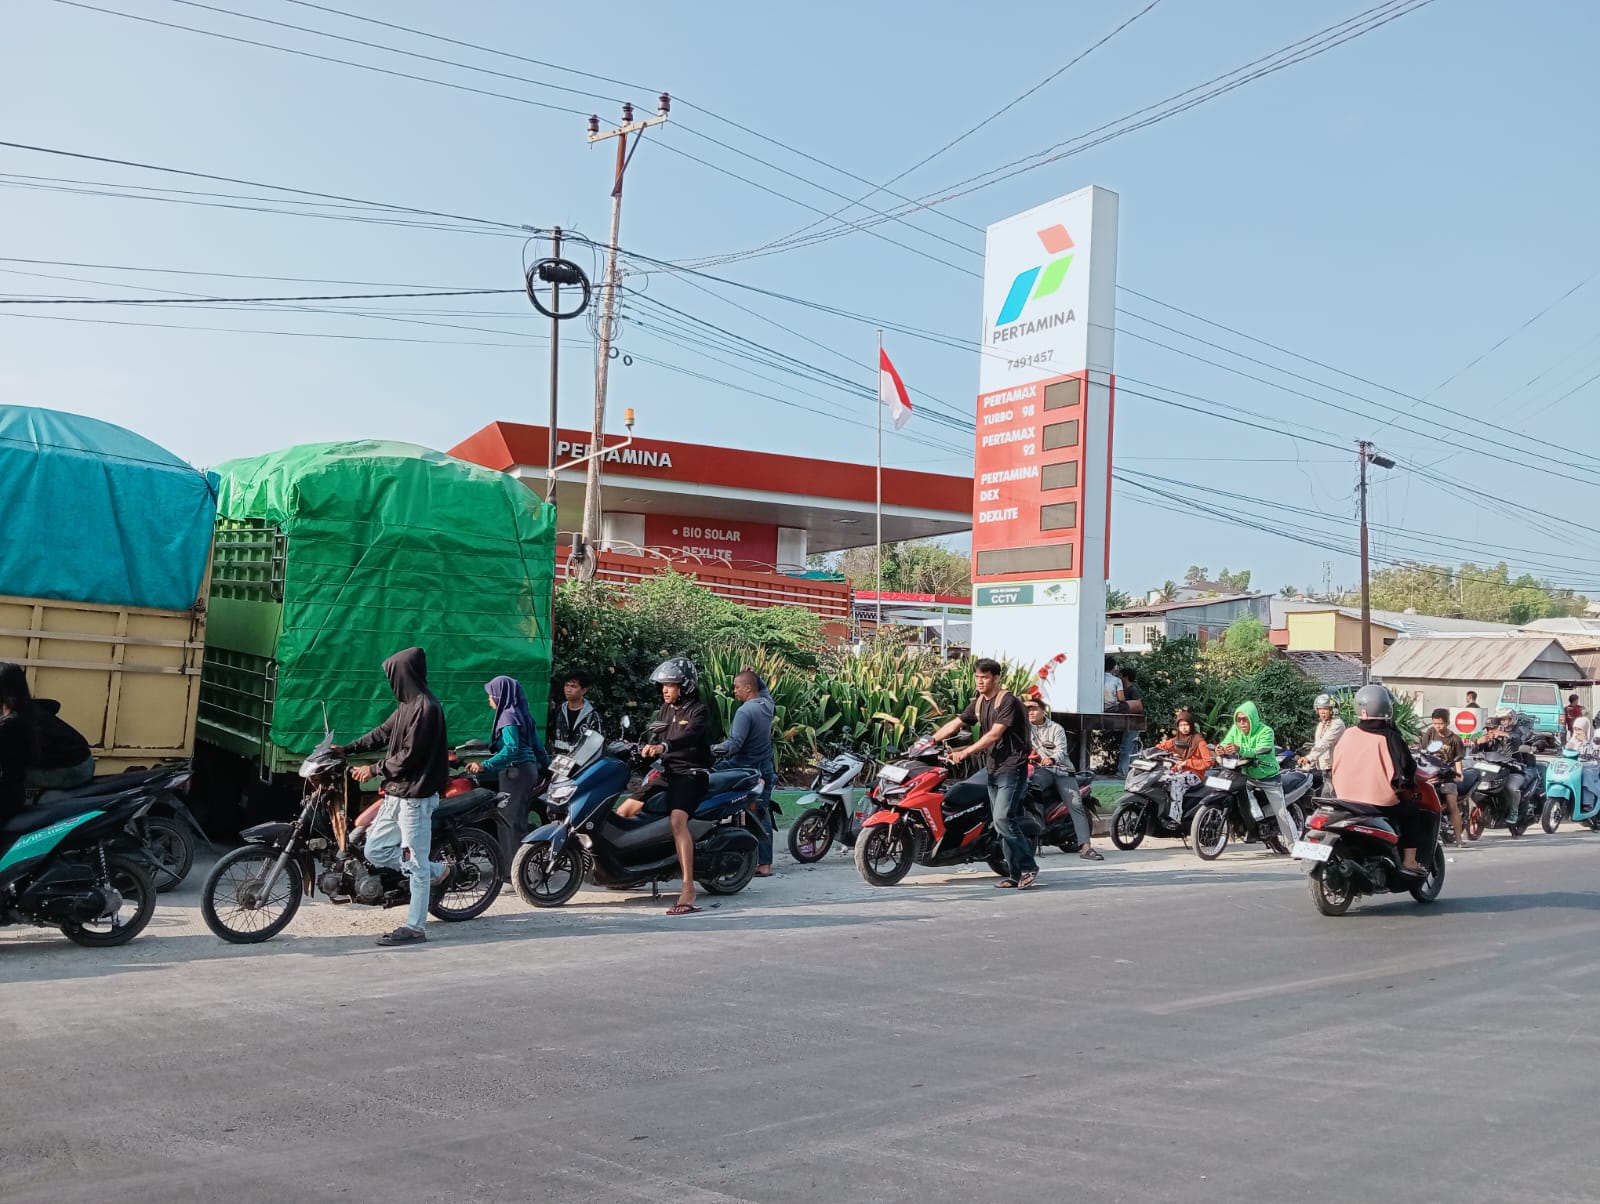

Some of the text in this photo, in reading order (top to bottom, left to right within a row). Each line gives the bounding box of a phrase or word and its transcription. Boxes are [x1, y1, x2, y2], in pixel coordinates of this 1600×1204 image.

[993, 308, 1076, 344] PERTAMINA
[1007, 350, 1054, 371] 7491457
[983, 385, 1037, 408] PERTAMAX
[983, 404, 1035, 425] TURBO 98
[982, 426, 1036, 448] PERTAMAX
[1022, 443, 1036, 457] 92
[980, 465, 1039, 485] PERTAMINA
[980, 488, 1000, 502] DEX
[979, 507, 1019, 524] DEXLITE
[682, 526, 741, 542] BIO SOLAR
[682, 545, 733, 561] DEXLITE
[991, 593, 1018, 604] CCTV
